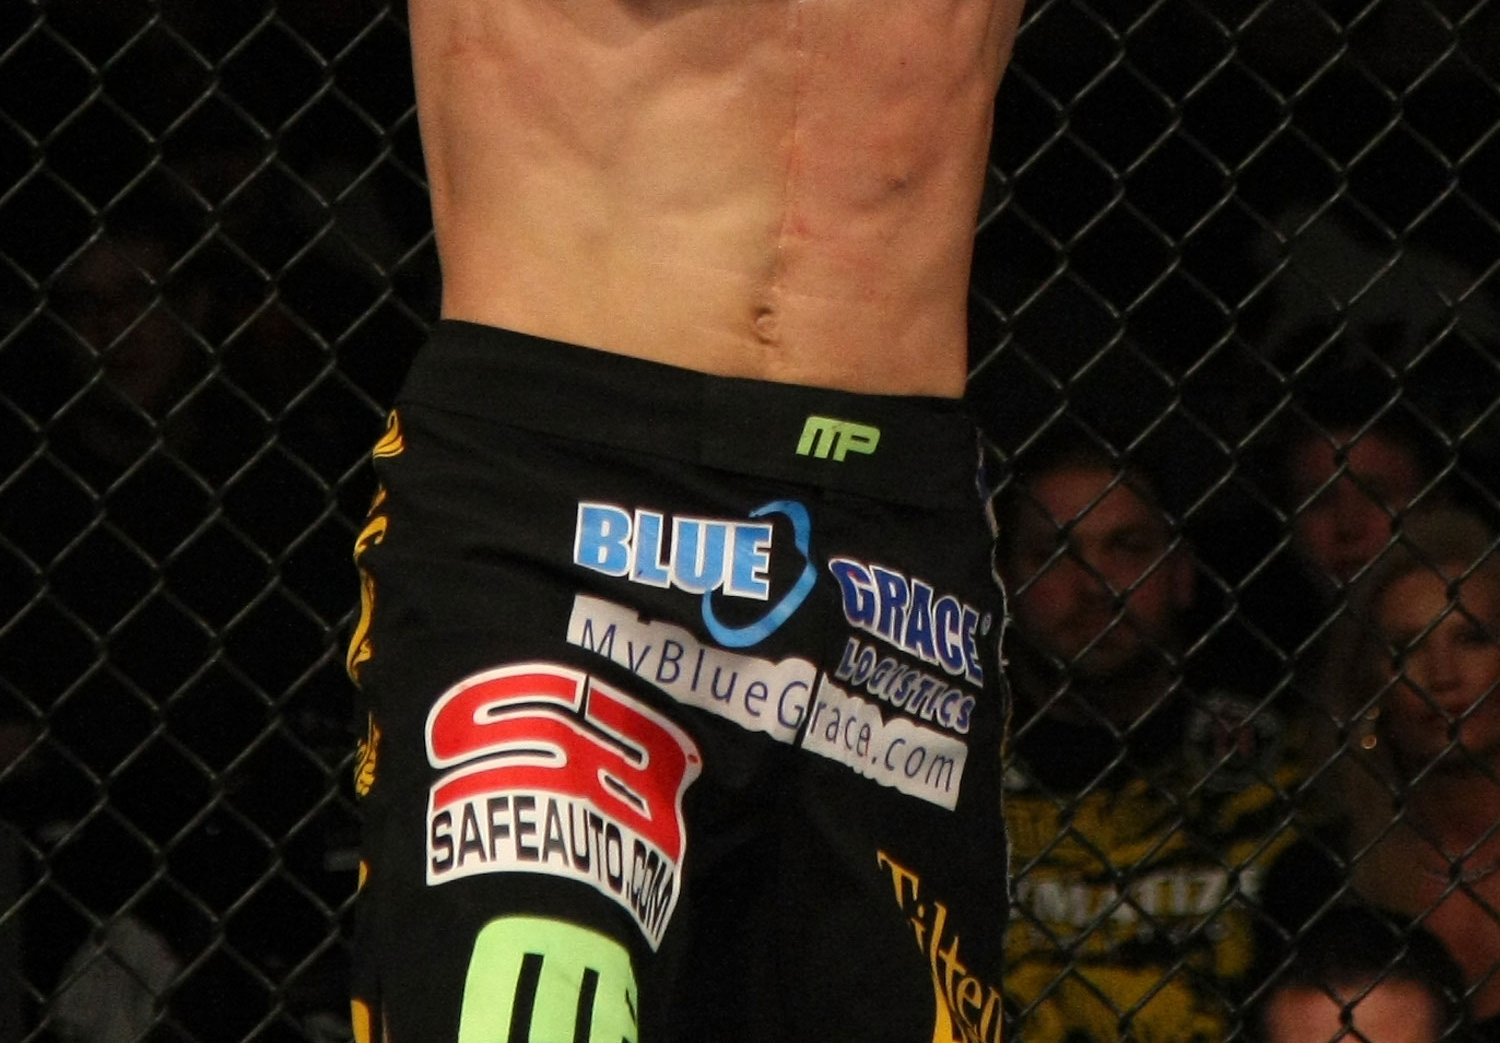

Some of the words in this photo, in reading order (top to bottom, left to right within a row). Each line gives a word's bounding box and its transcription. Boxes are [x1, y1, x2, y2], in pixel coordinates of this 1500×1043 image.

[573, 502, 773, 601] BLUE
[828, 558, 984, 688] GRACE
[835, 637, 976, 735] LOGISTICS
[430, 794, 676, 943] SAFEAUTO.COM
